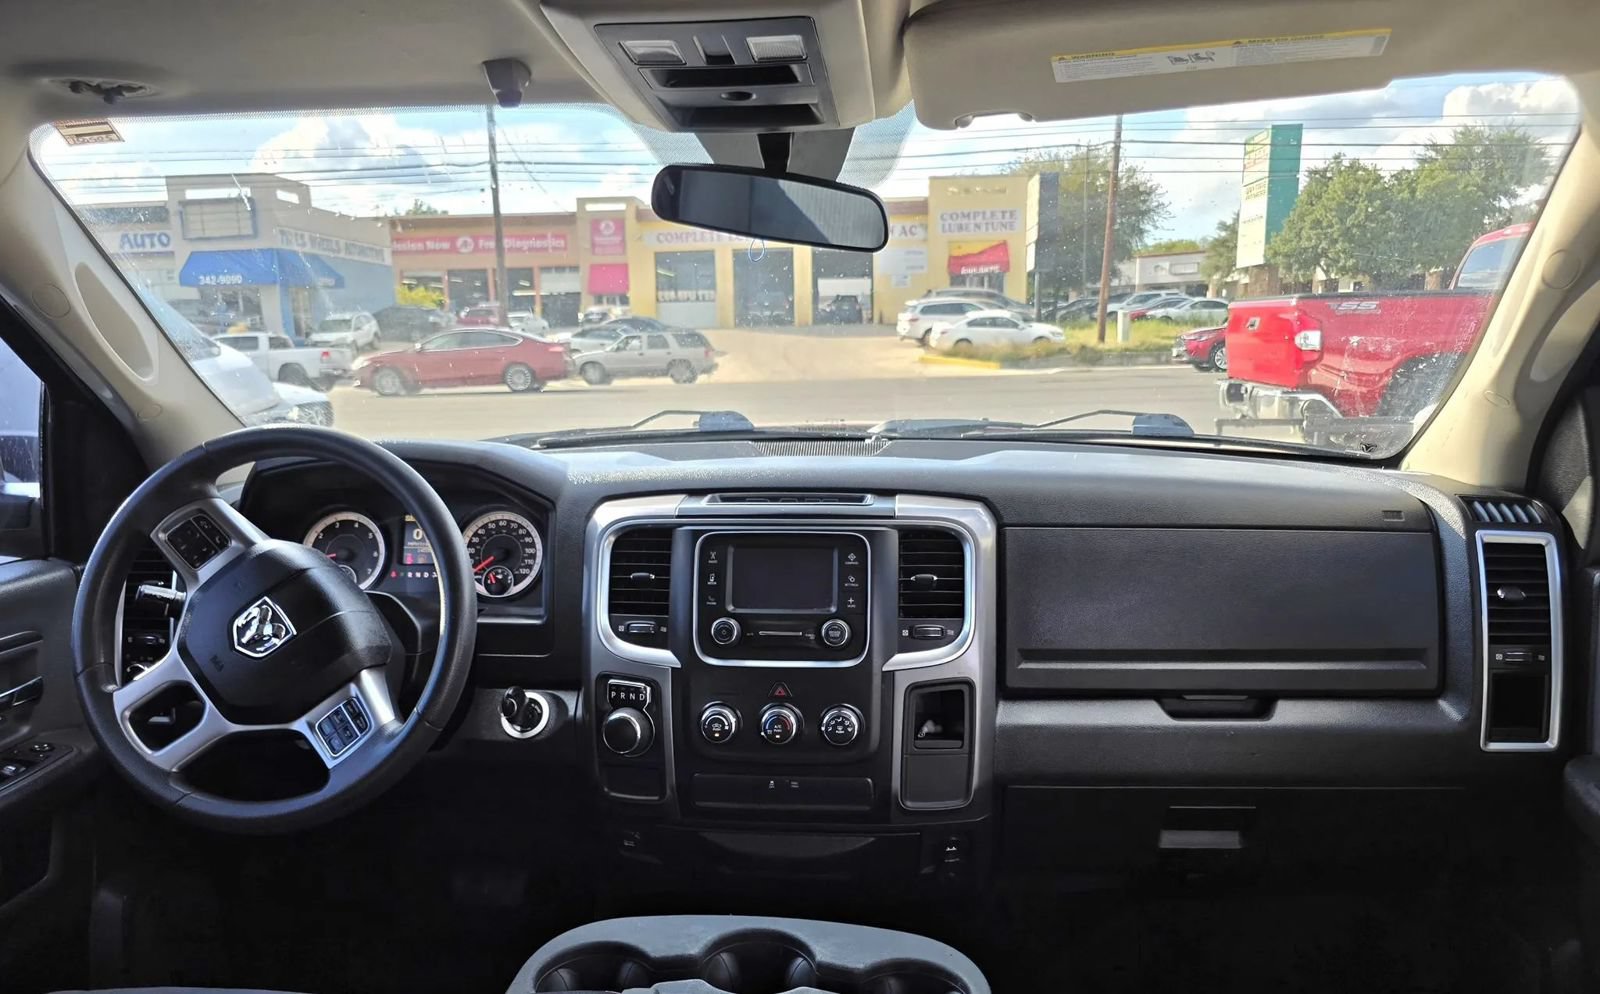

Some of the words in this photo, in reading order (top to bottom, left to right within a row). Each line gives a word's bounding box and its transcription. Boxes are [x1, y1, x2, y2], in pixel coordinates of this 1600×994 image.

[940, 210, 1017, 221] COMPLETE
[120, 231, 171, 249] AUTO
[656, 231, 723, 244] COMPLETE
[479, 238, 496, 249] Fre
[413, 528, 423, 540] 0
[611, 691, 616, 699] P
[620, 691, 626, 700] R
[630, 692, 636, 700] N
[640, 693, 645, 701] D
